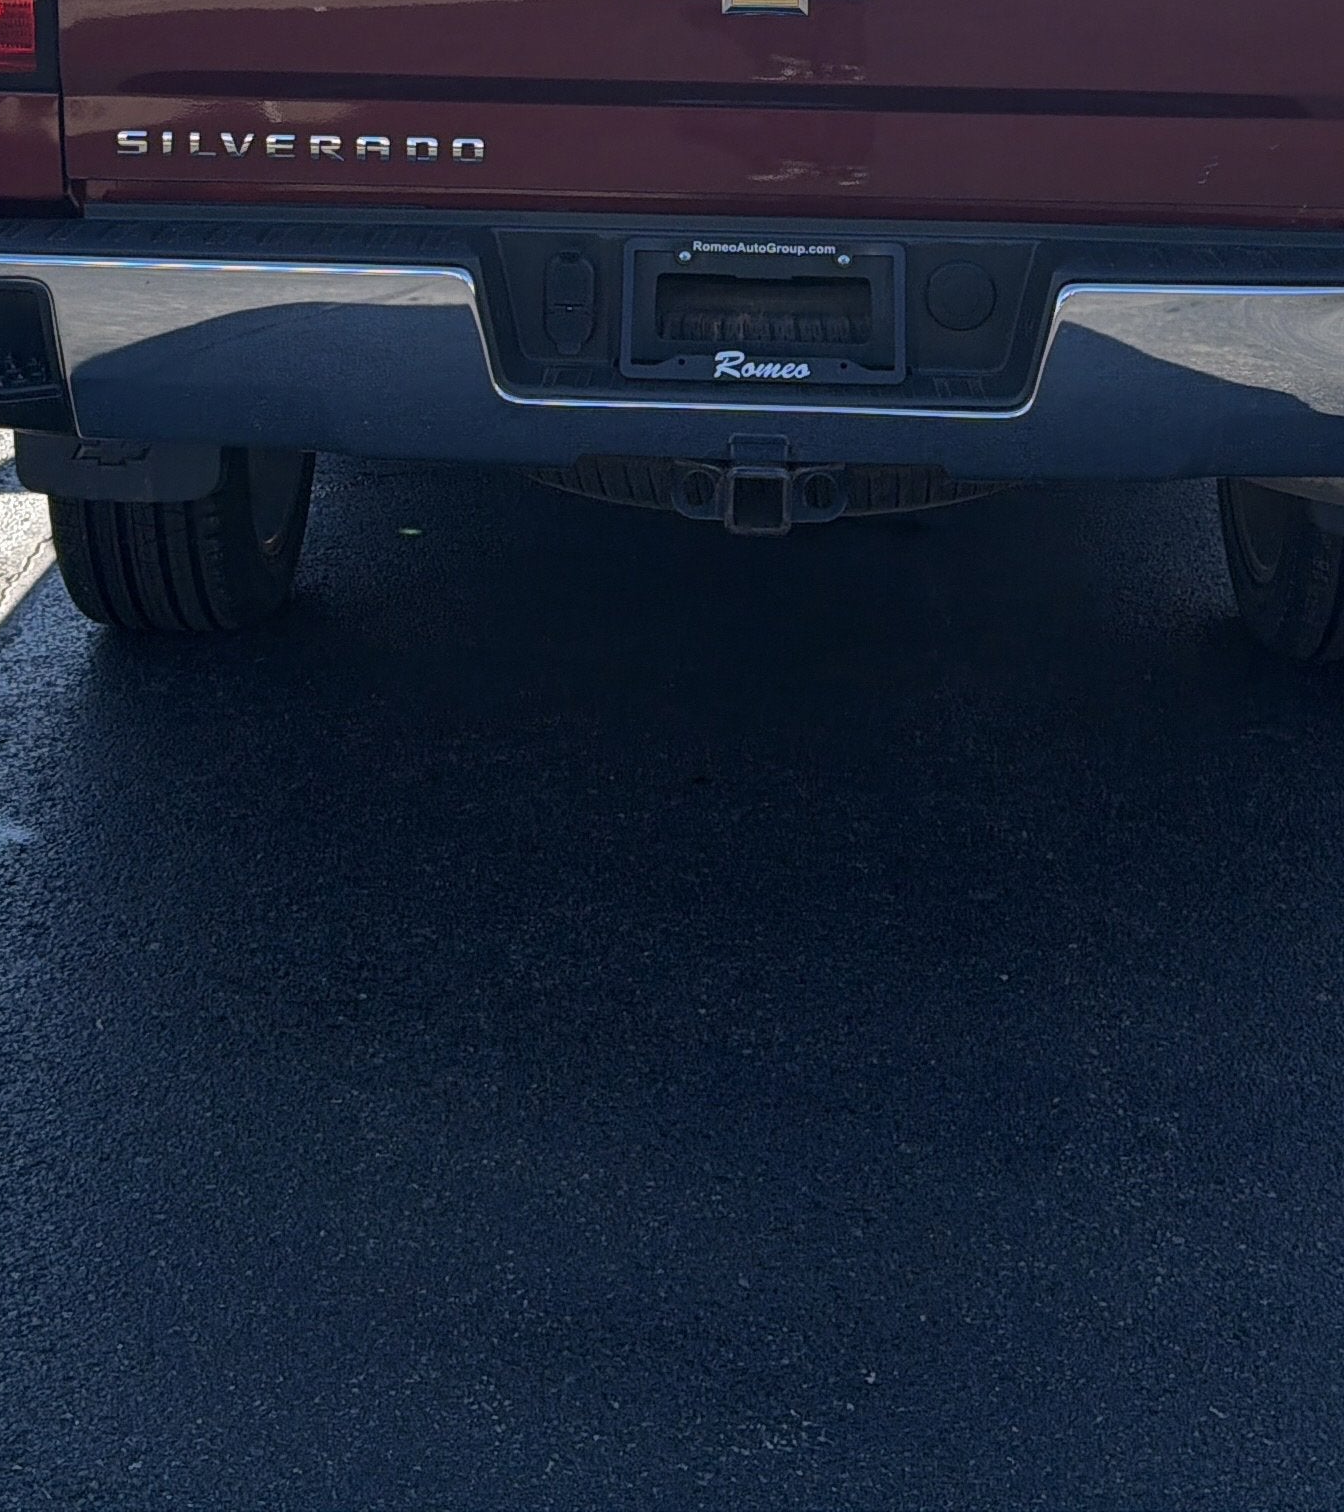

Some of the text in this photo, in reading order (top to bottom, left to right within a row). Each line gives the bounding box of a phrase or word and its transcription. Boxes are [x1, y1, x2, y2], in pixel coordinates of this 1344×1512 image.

[116, 130, 486, 163] SILVERADO
[693, 240, 837, 256] RomeoAutoGroup.com
[713, 350, 811, 379] Romeo
